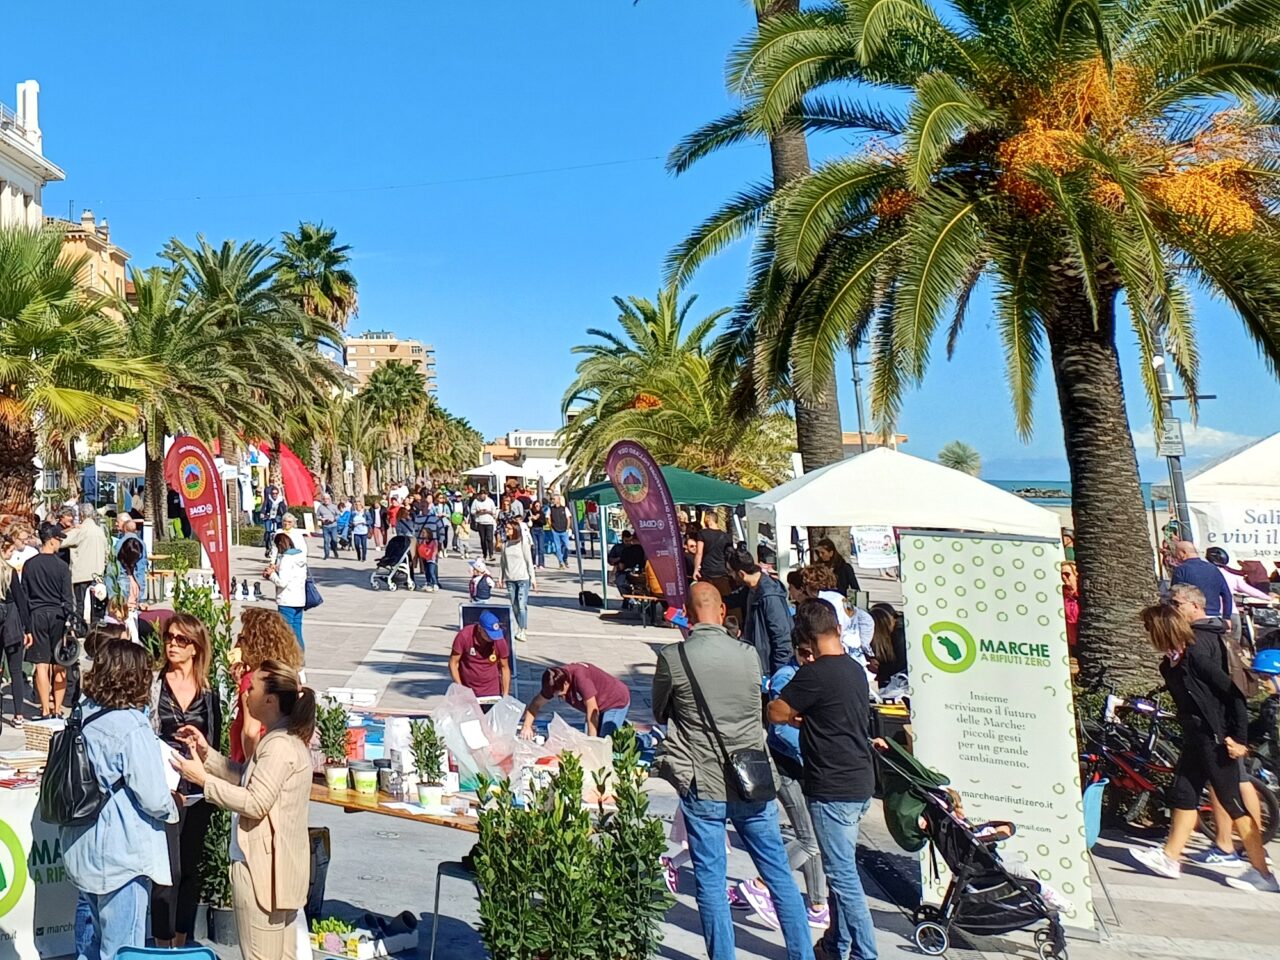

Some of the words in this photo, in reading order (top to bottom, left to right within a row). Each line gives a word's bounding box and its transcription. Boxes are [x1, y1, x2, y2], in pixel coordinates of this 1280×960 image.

[1207, 531, 1217, 543] e
[1222, 528, 1259, 544] vivi
[1266, 529, 1278, 544] il
[979, 639, 1051, 657] MARCHE
[981, 653, 990, 661] A
[990, 653, 1023, 665] RIFIUTI
[1024, 656, 1052, 667] ZERO
[969, 691, 1009, 704] Insieme
[944, 703, 993, 715] scriviamo
[994, 705, 1001, 716] il
[1003, 706, 1037, 720] futuro
[956, 714, 981, 725] delle
[983, 717, 1026, 731] Marche:
[962, 728, 995, 741] piccoli
[997, 732, 1022, 744] gesti
[957, 741, 975, 751] per
[977, 743, 990, 752] un
[993, 744, 1029, 757] grande
[958, 752, 1030, 769] cambiamento.
[961, 790, 1054, 809] marchearifiutizero.it
[32, 838, 62, 866] MA
[34, 869, 44, 884] A
[46, 866, 69, 884] RIF
[46, 923, 75, 935] march
